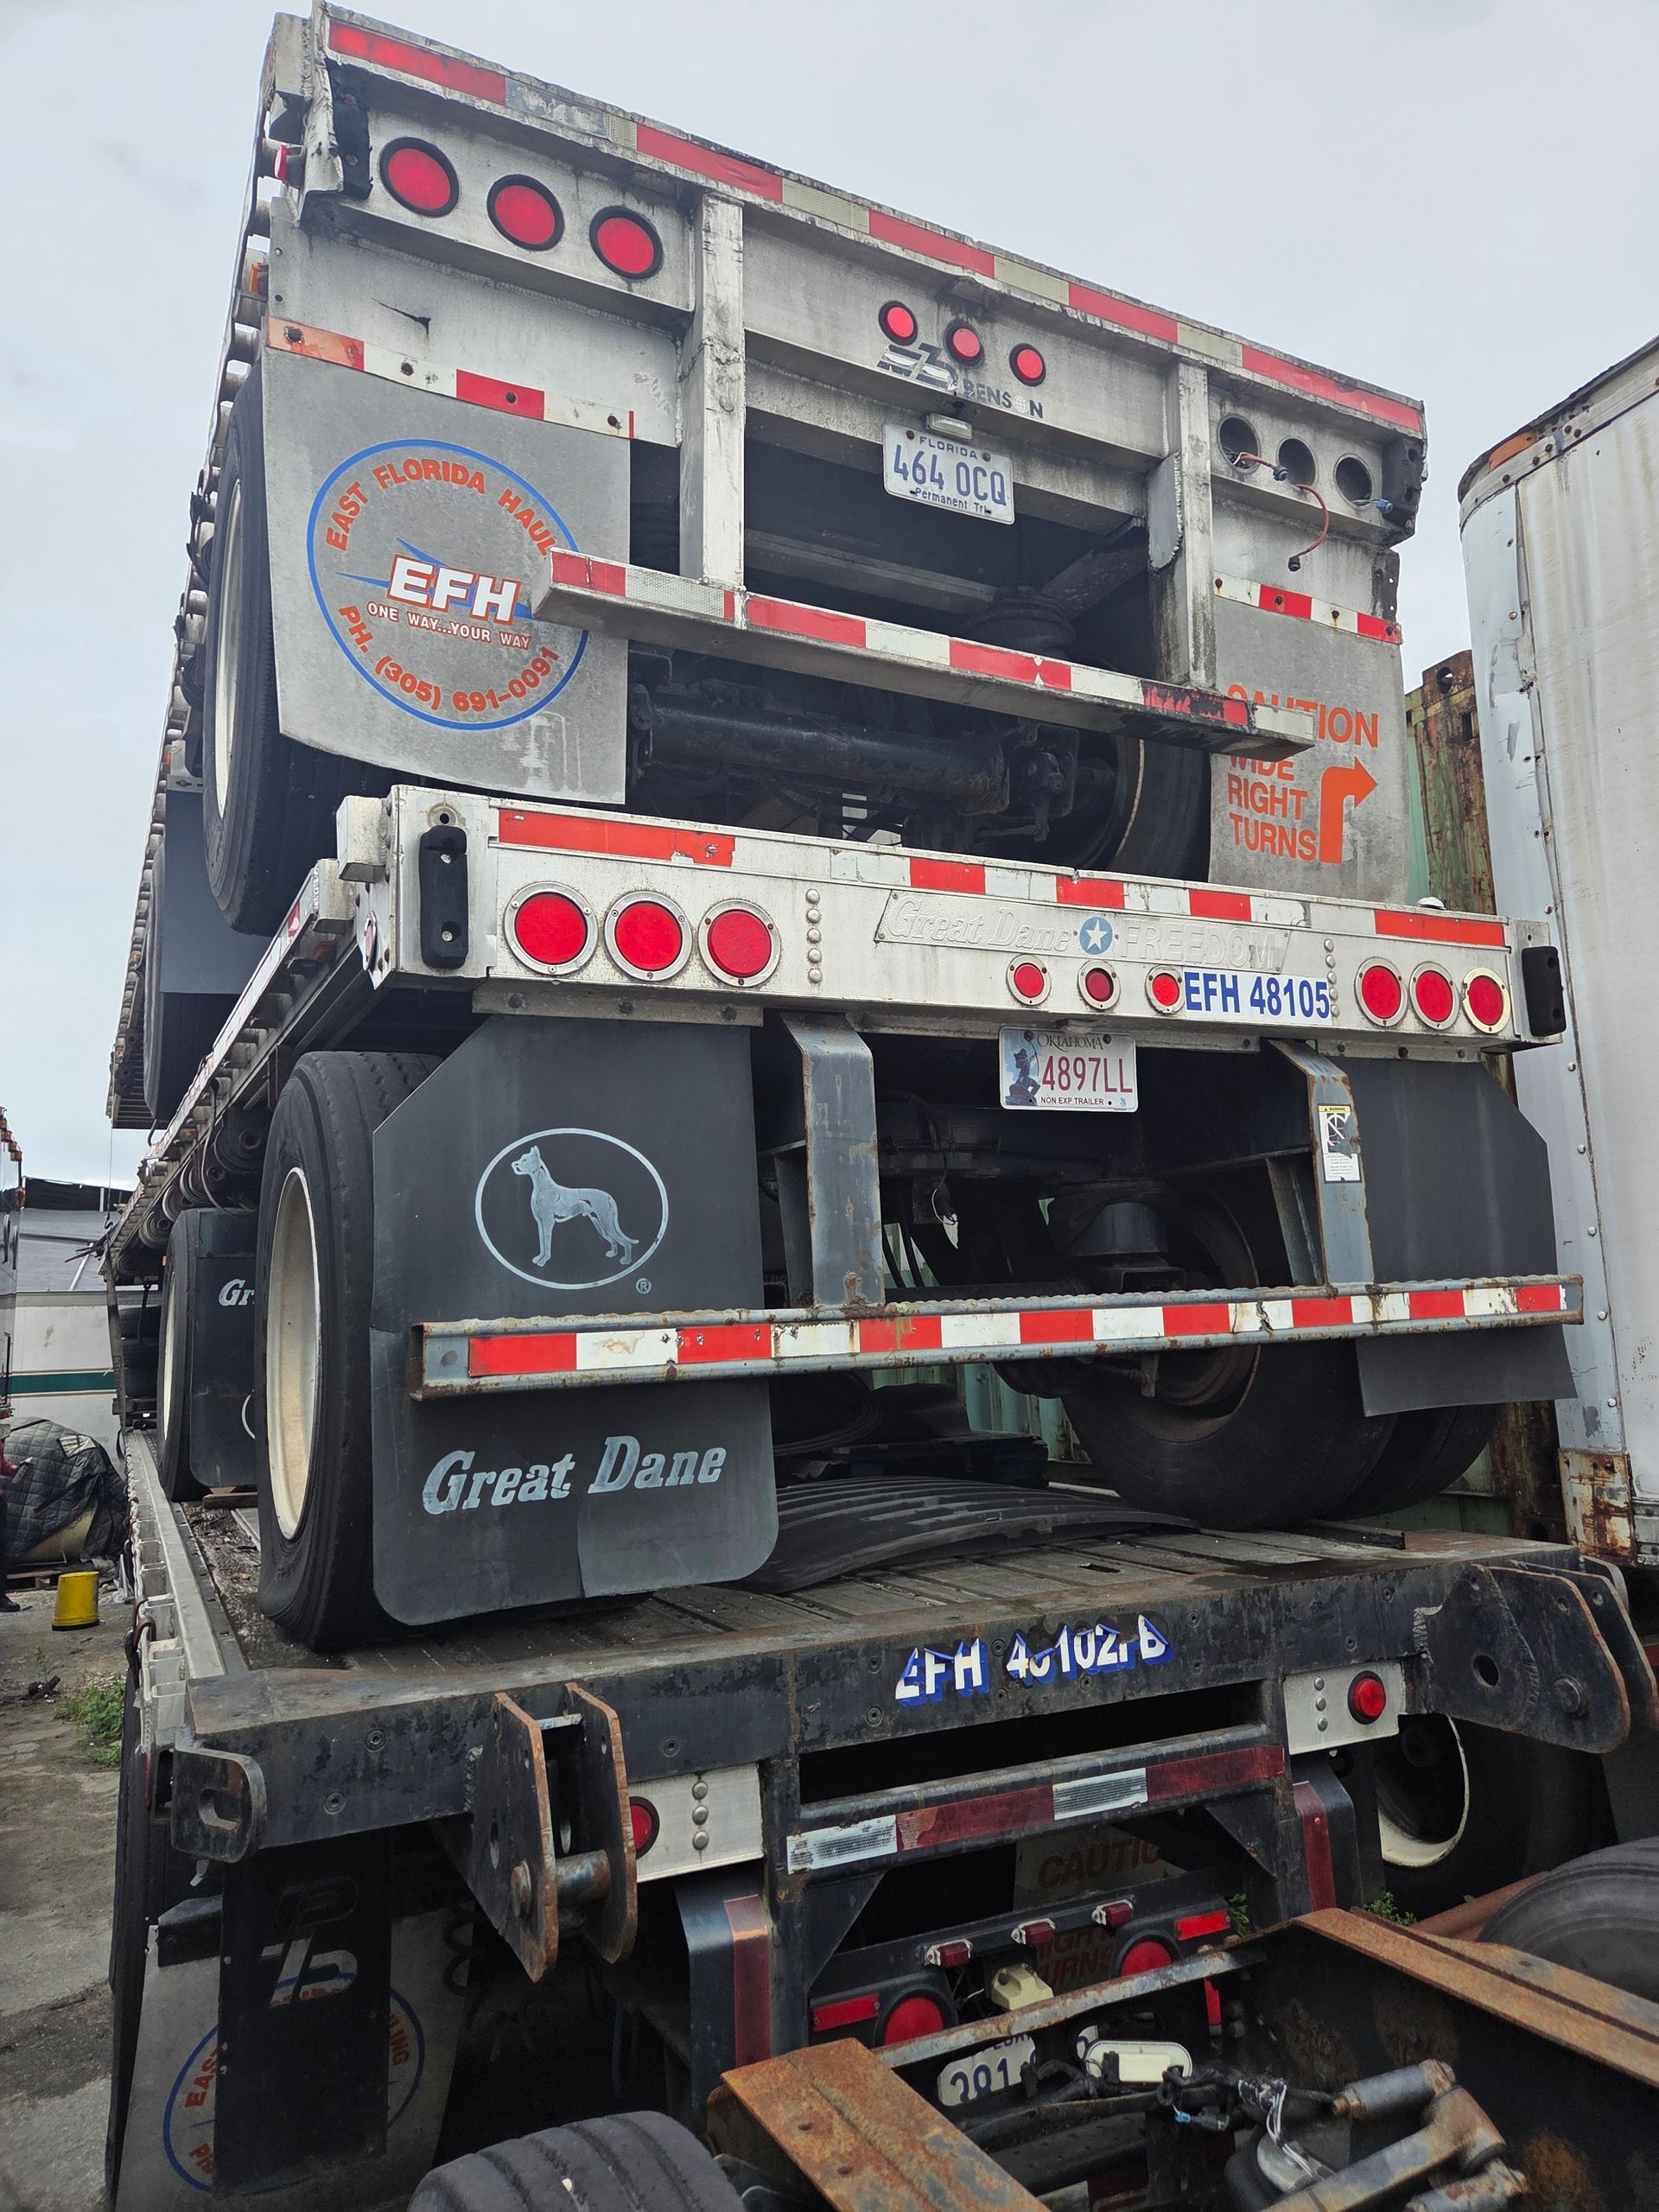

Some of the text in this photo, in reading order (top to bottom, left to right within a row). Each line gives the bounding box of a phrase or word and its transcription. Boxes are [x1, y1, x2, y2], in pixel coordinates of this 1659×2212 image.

[893, 444, 944, 490] 464
[919, 436, 977, 460] FLORIDA
[325, 481, 370, 551] EAST
[372, 458, 486, 494] FLORIDA
[916, 487, 968, 509] Permanent
[386, 554, 521, 626] EFH
[366, 602, 399, 622] ONE
[500, 632, 533, 652] WAY
[338, 605, 560, 713] PH. (305) 691-0091
[1227, 772, 1308, 820] RIGHT
[1229, 812, 1318, 862] TURNS
[887, 896, 1277, 969] Great Dane FREEDOM
[1184, 971, 1331, 1019] EFH 48105
[1037, 1033, 1104, 1052] OKLAHOMA
[1042, 1055, 1133, 1093] 4897LL
[422, 1434, 727, 1516] Great Dane
